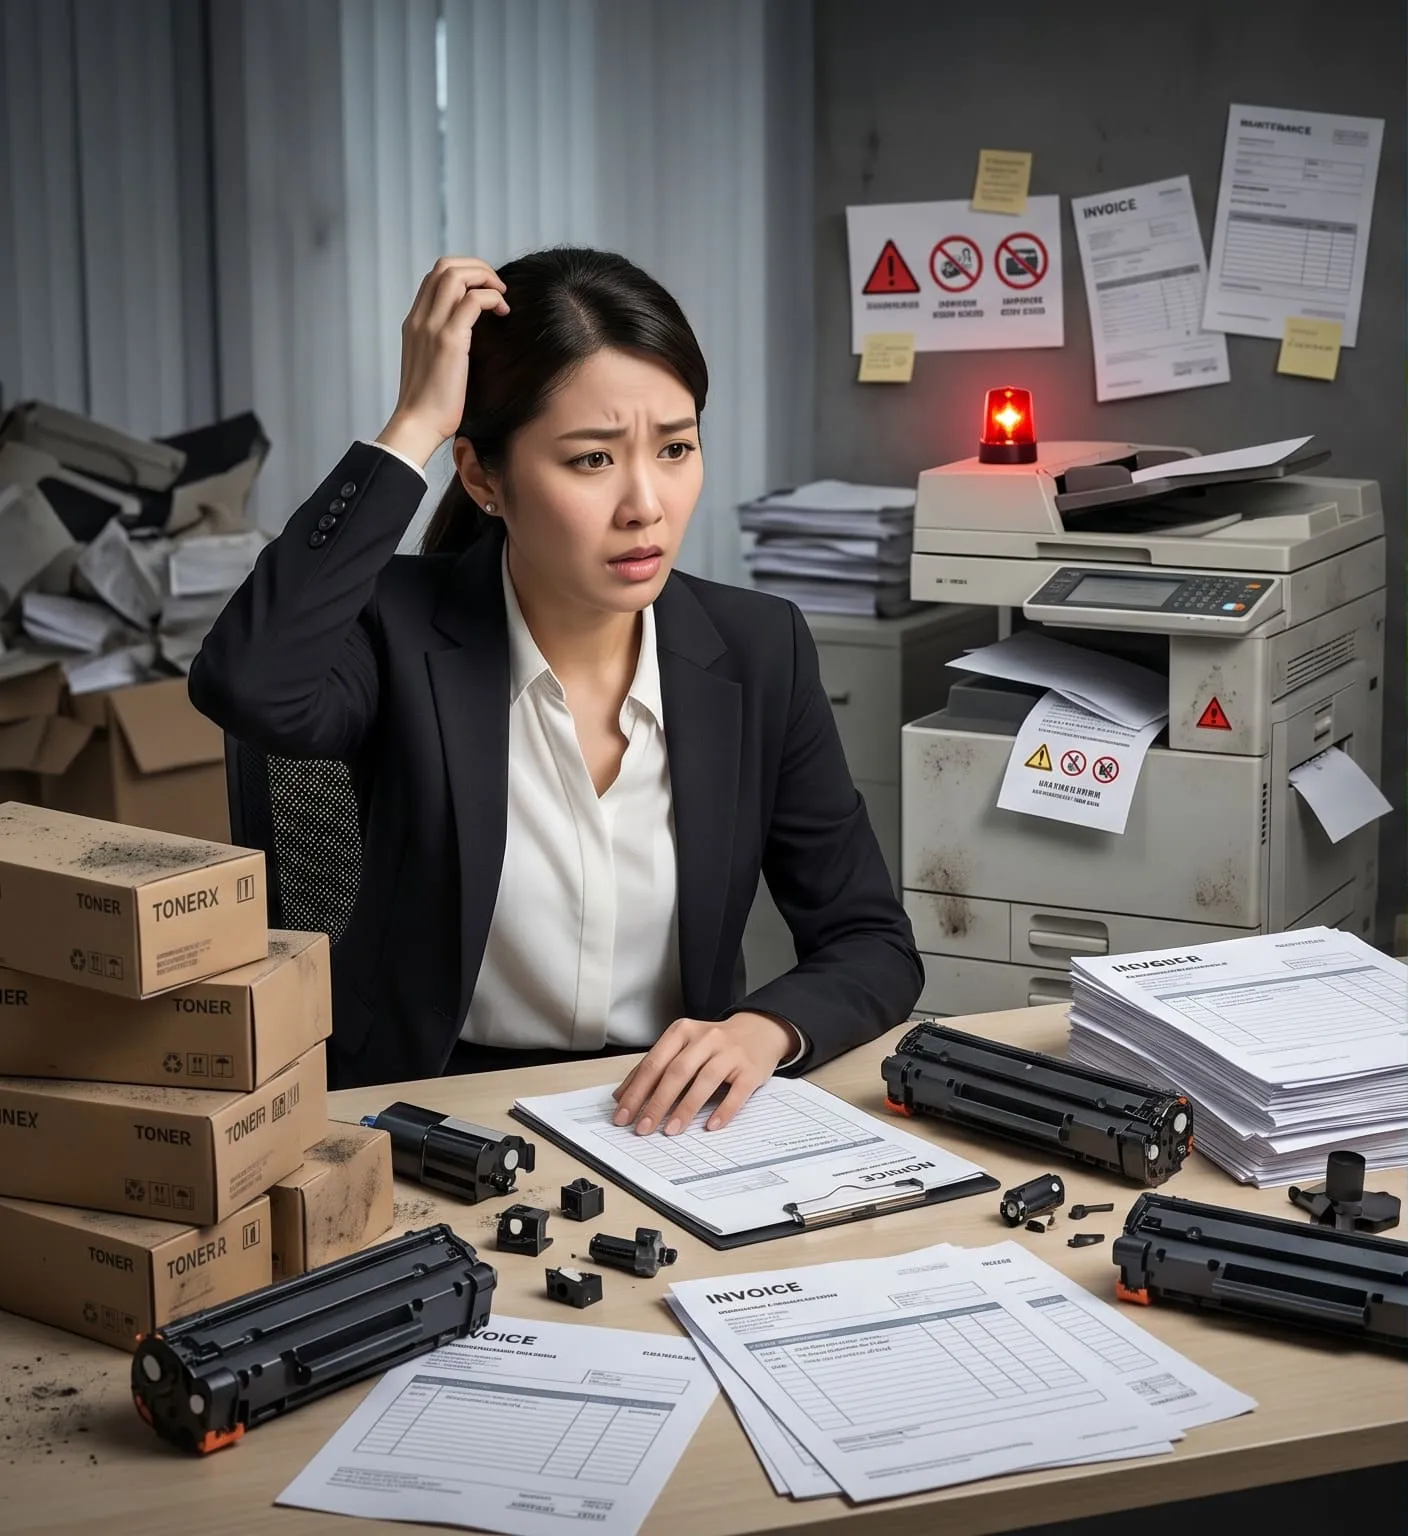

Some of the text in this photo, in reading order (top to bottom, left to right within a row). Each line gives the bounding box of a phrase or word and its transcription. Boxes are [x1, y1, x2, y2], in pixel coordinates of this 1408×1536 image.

[1083, 199, 1137, 219] INVOICE
[76, 892, 122, 915] TONER
[152, 886, 220, 922] TONERX
[0, 988, 30, 1006] ER
[172, 998, 232, 1015] TONER
[0, 1108, 39, 1129] NEX
[134, 1124, 192, 1146] TONER
[88, 1246, 135, 1273] TONER
[705, 1282, 803, 1304] INVOICE
